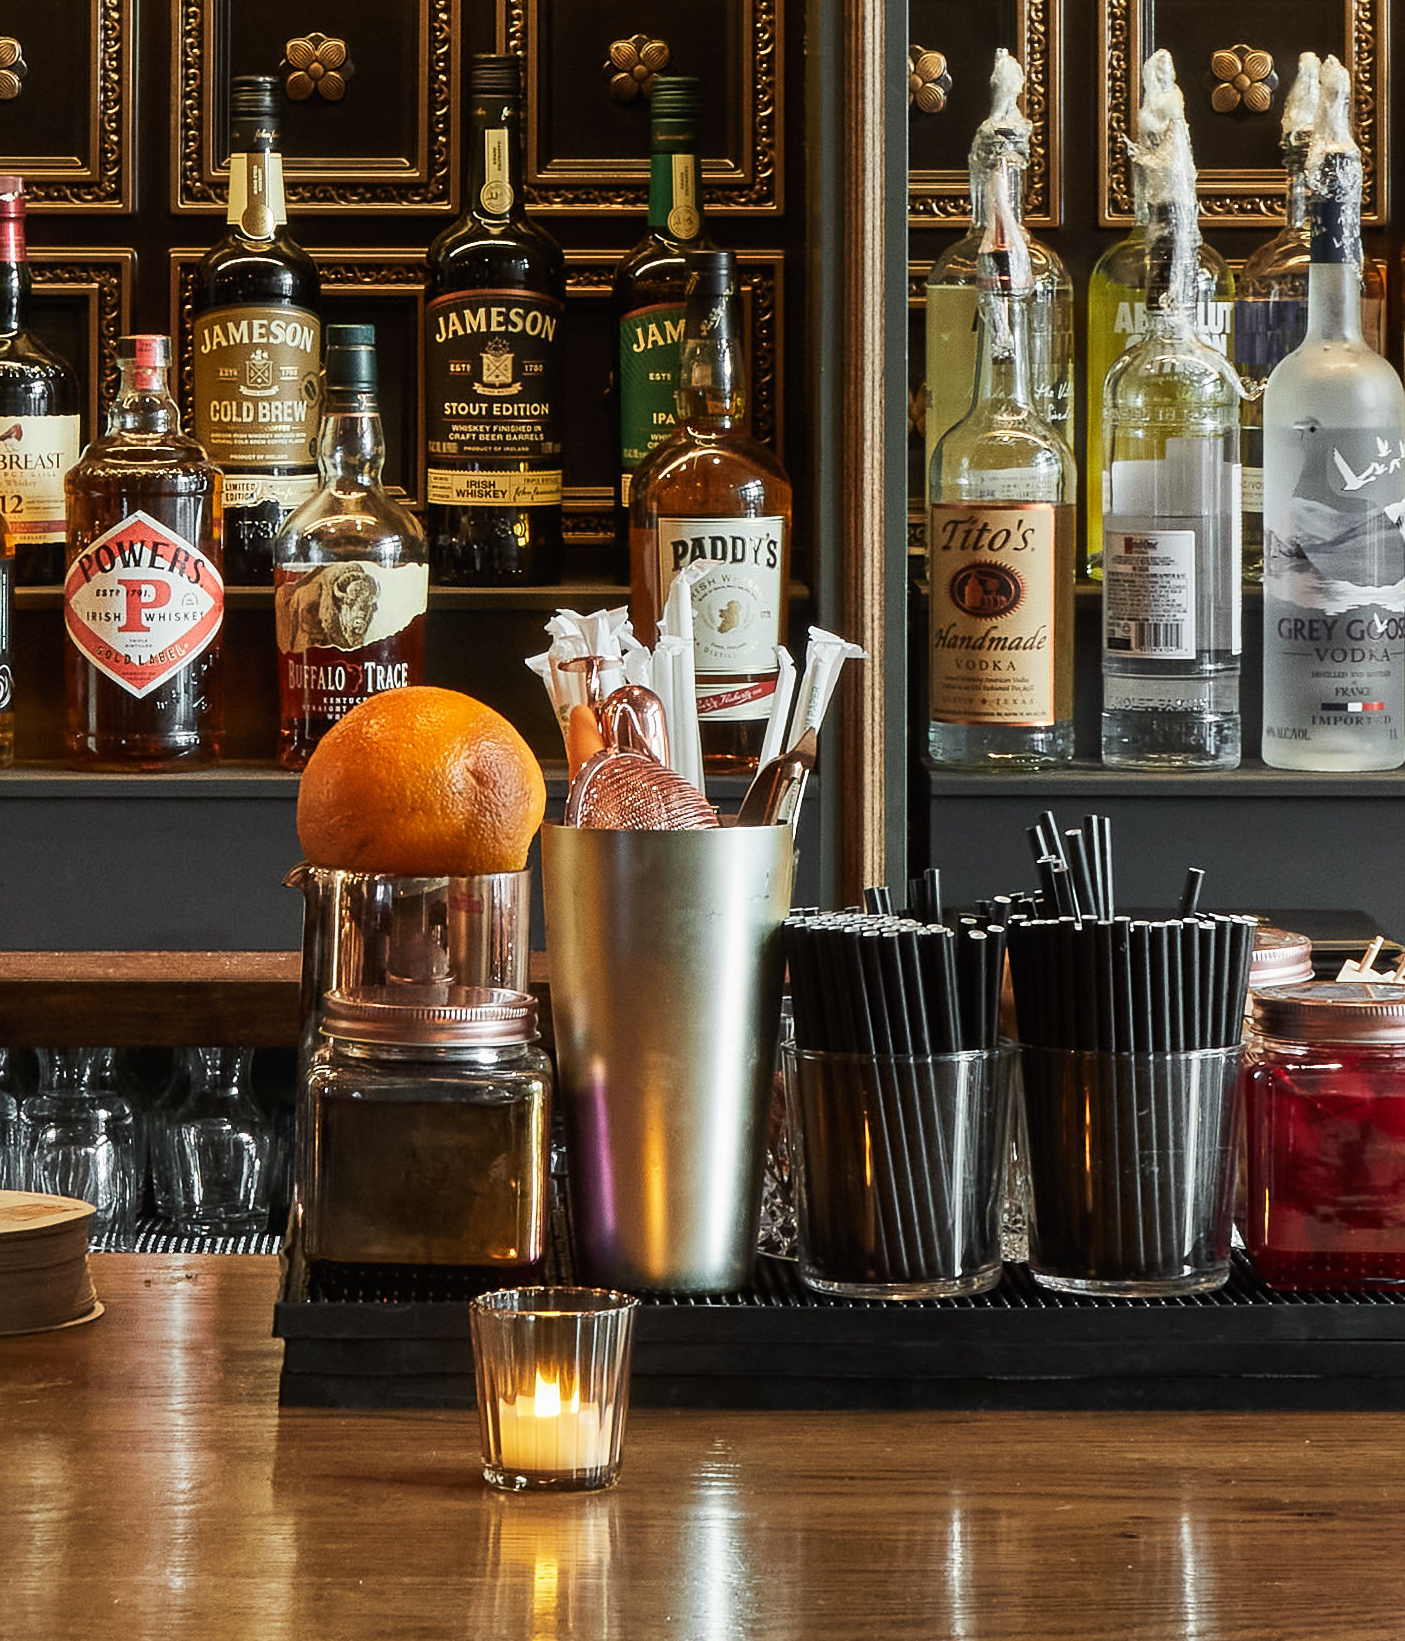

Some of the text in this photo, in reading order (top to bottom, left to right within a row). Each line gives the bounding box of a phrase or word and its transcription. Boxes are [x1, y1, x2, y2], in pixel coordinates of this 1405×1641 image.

[435, 306, 556, 343] JAMESON
[1113, 301, 1234, 334] ABLUT
[201, 319, 315, 354] JAMESON
[210, 400, 308, 422] COLD BREW
[444, 403, 549, 415] STOUT EDITION
[652, 413, 676, 425] IPA
[449, 433, 544, 441] CRAFT BEER BARRELS
[451, 424, 491, 432] WHISKEY
[493, 425, 532, 433] FINISHED
[225, 483, 255, 491] LIMITED
[456, 489, 508, 498] WHISKEY
[466, 480, 495, 489] IRISH
[941, 515, 1035, 552] Tito's
[78, 539, 205, 584] POWERS
[671, 533, 778, 572] PADDY'S
[117, 579, 172, 632] P
[87, 611, 203, 621] IRISH WHISKEY
[935, 623, 1047, 651] Handmade
[1278, 617, 1405, 641] GREY GOOS
[96, 646, 131, 665] GOLD
[955, 659, 1016, 671] VODKA
[1315, 648, 1391, 663] VODKA
[288, 659, 408, 693] BUFFALO TRACE
